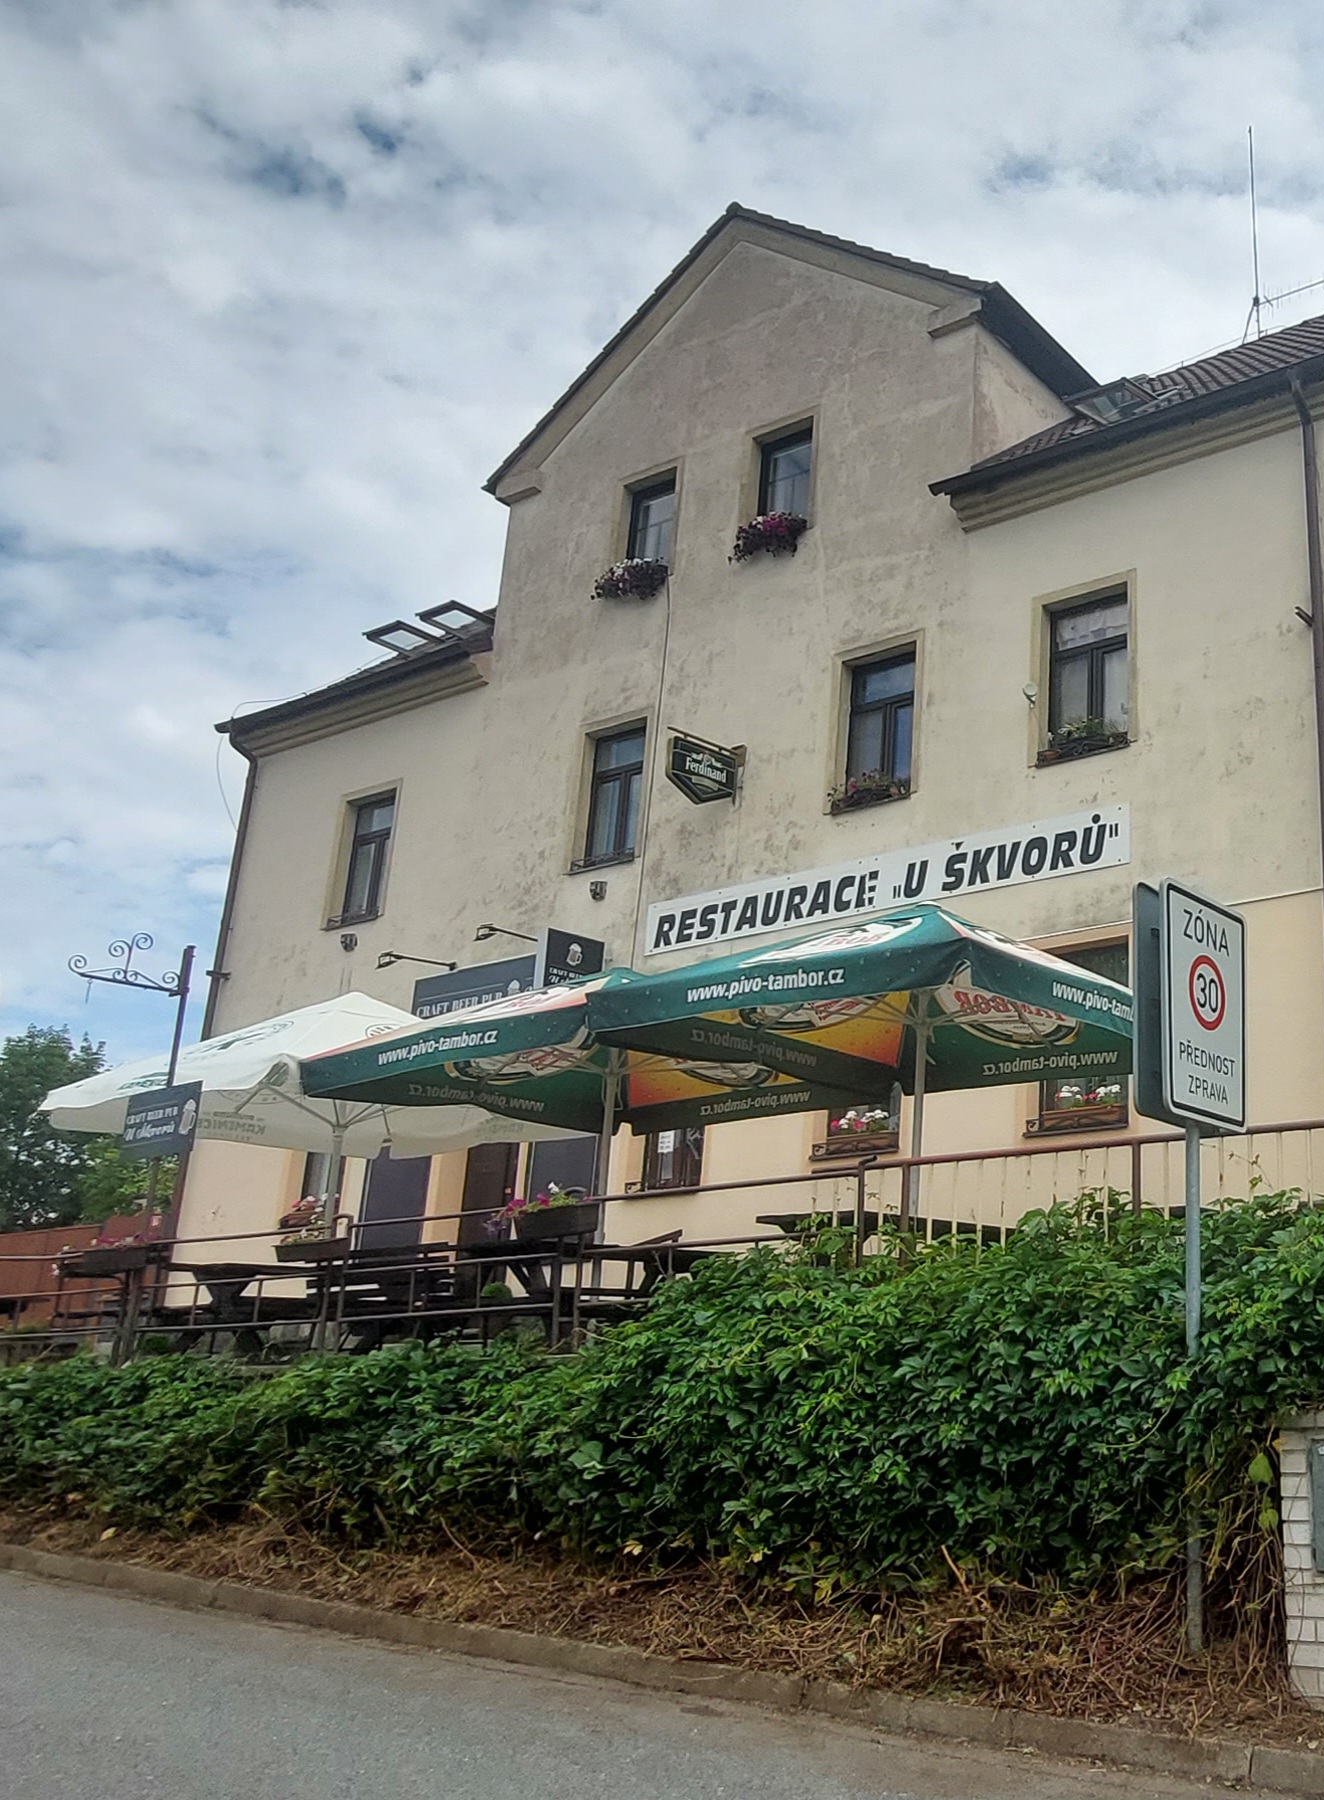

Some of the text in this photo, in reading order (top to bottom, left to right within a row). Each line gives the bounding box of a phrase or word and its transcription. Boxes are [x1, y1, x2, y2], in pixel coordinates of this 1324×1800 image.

[685, 756, 727, 783] Ferdinand
[652, 870, 881, 949] RESTAURACE
[1183, 908, 1230, 957] ZÓNA
[687, 968, 845, 1002] www.pivo-tambor.cz
[1196, 972, 1219, 1014] 30
[416, 1002, 449, 1018] CRAFT
[378, 1029, 498, 1066] www.pivo-tambor.cz
[1179, 1039, 1236, 1077] PŘEDNOST
[1188, 1074, 1228, 1105] ZPRAVA
